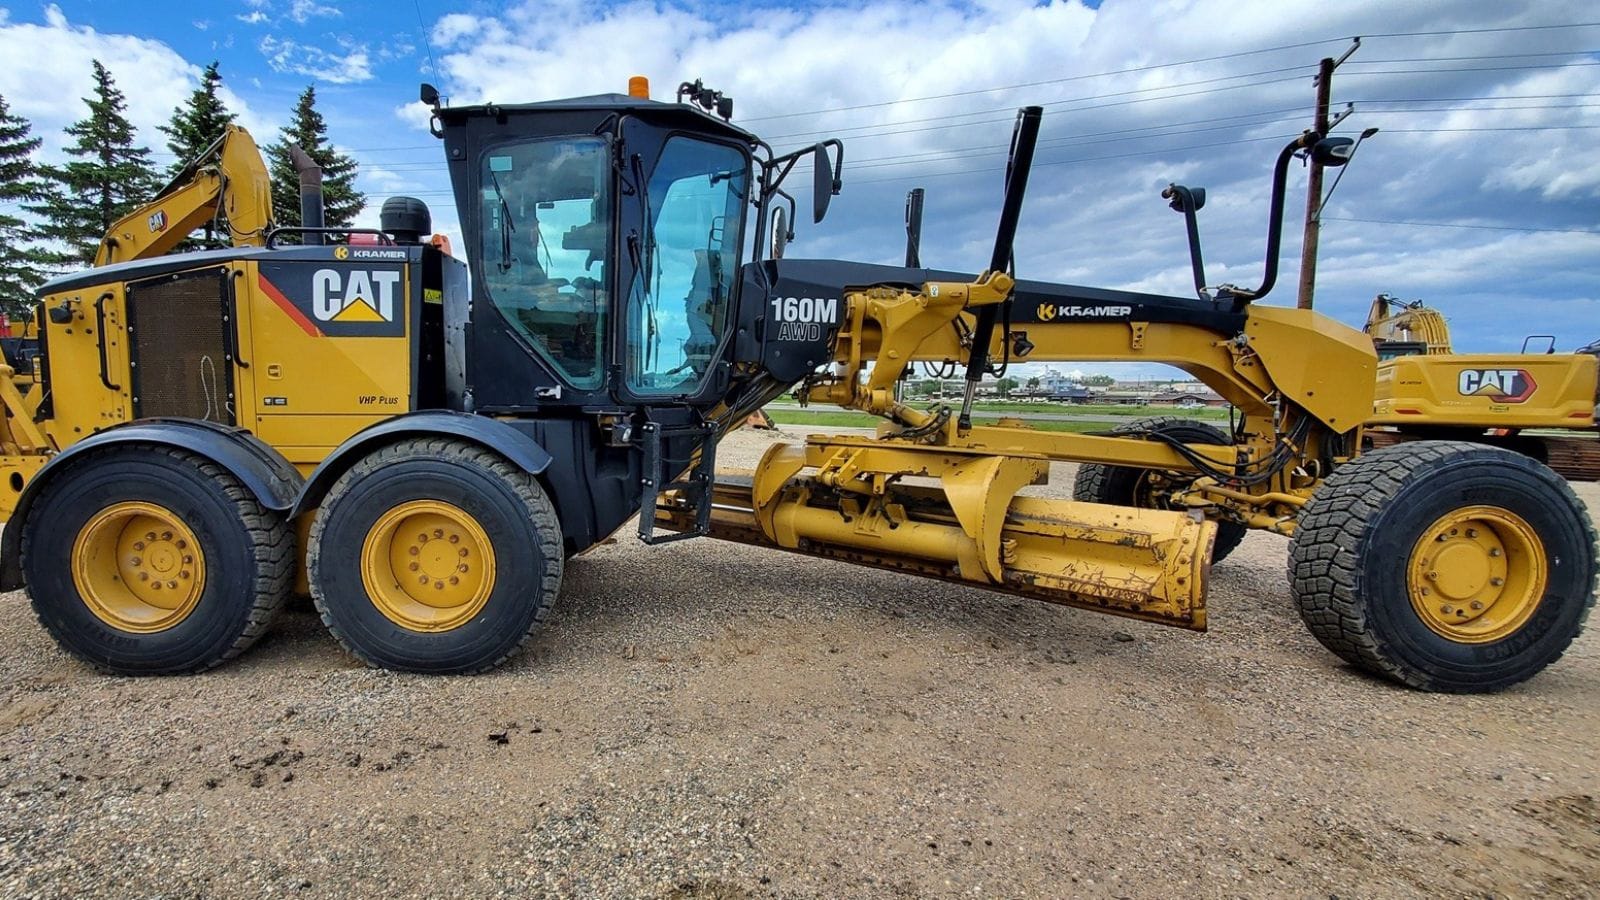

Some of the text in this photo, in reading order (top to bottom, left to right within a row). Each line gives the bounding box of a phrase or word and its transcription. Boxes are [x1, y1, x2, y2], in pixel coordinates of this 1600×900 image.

[148, 211, 164, 232] CAT
[353, 250, 406, 259] KRAMER
[312, 268, 400, 322] CAT
[771, 296, 837, 324] 160M
[1058, 305, 1132, 317] KRAMER
[777, 321, 821, 342] AWD
[1459, 369, 1519, 396] CAT
[359, 395, 377, 405] VHP
